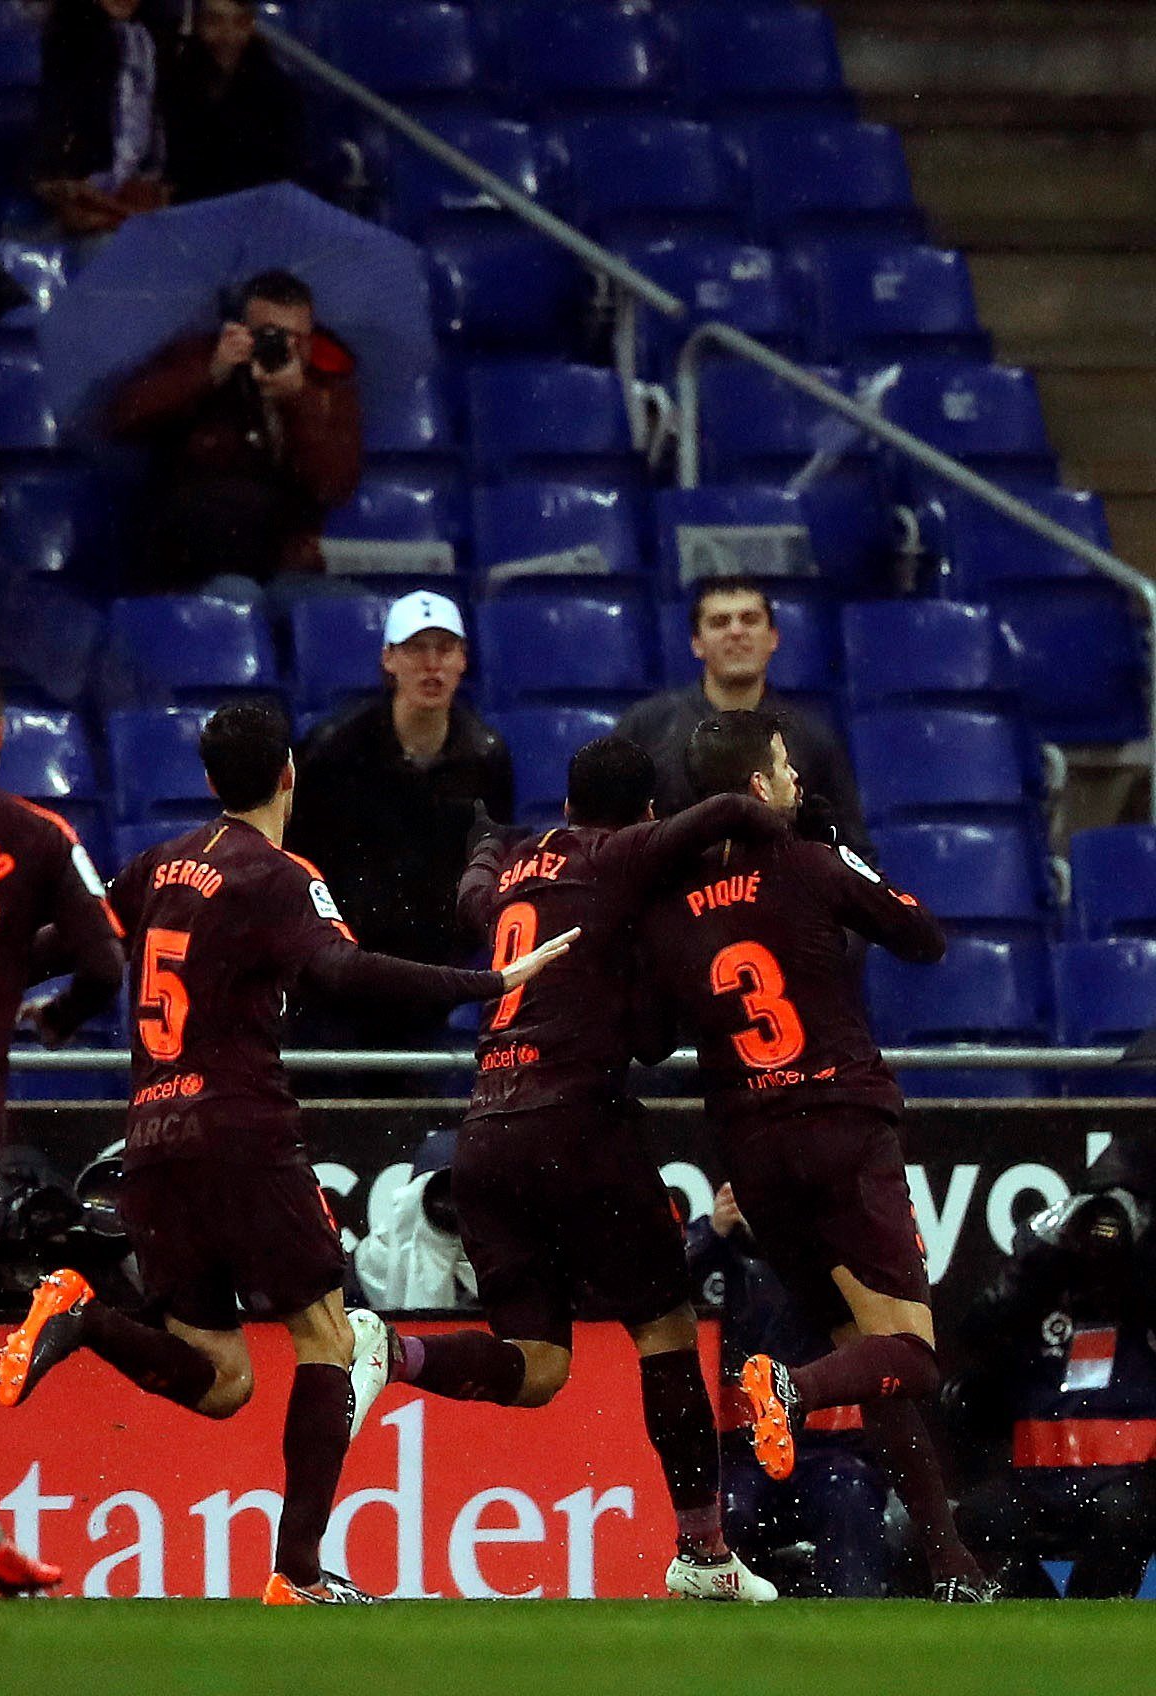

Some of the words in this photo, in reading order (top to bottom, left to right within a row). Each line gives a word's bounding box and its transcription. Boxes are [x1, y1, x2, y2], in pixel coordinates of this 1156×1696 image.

[154, 859, 224, 898] SERGIO
[499, 852, 567, 893] SUÁEZ
[686, 869, 763, 917] PIQUÉ
[491, 902, 538, 1030] 9
[138, 928, 192, 1062] 5
[710, 940, 805, 1068] 3
[134, 1074, 181, 1106] unicef
